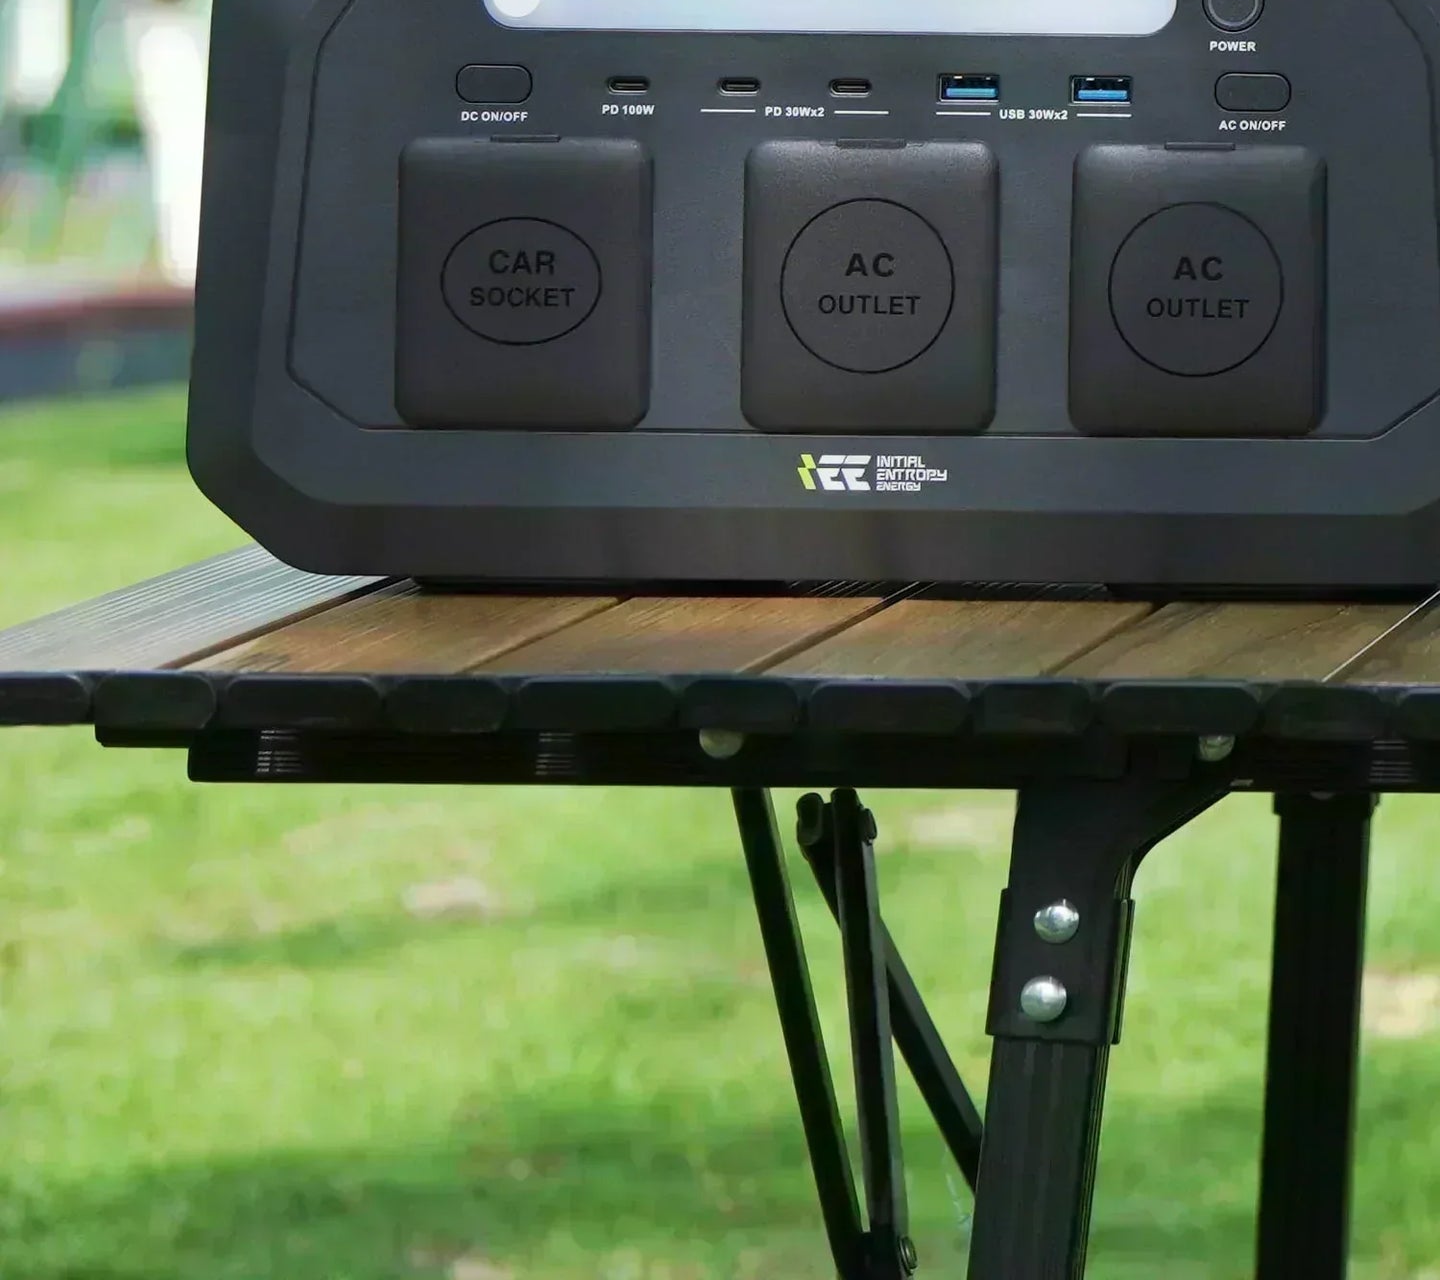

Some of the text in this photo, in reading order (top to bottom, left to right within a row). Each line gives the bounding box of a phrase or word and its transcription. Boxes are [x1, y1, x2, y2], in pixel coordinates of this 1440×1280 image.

[1209, 40, 1257, 52] POWER
[460, 110, 529, 122] DC ON/OFF
[601, 104, 655, 115] PD 100W
[764, 105, 825, 118] PD 30Wx2
[999, 108, 1070, 121] USB 30Wx2
[1218, 119, 1287, 131] AC ON/OFF
[487, 249, 556, 276] CAR
[844, 252, 896, 278] AC
[1172, 255, 1224, 281] AC
[469, 286, 576, 308] SOCKET
[817, 293, 921, 315] OUTLET
[1146, 297, 1251, 319] OUTLET
[876, 455, 926, 469] INITIAL
[876, 468, 948, 482] ENTROPY
[875, 481, 922, 492] ENERGY
